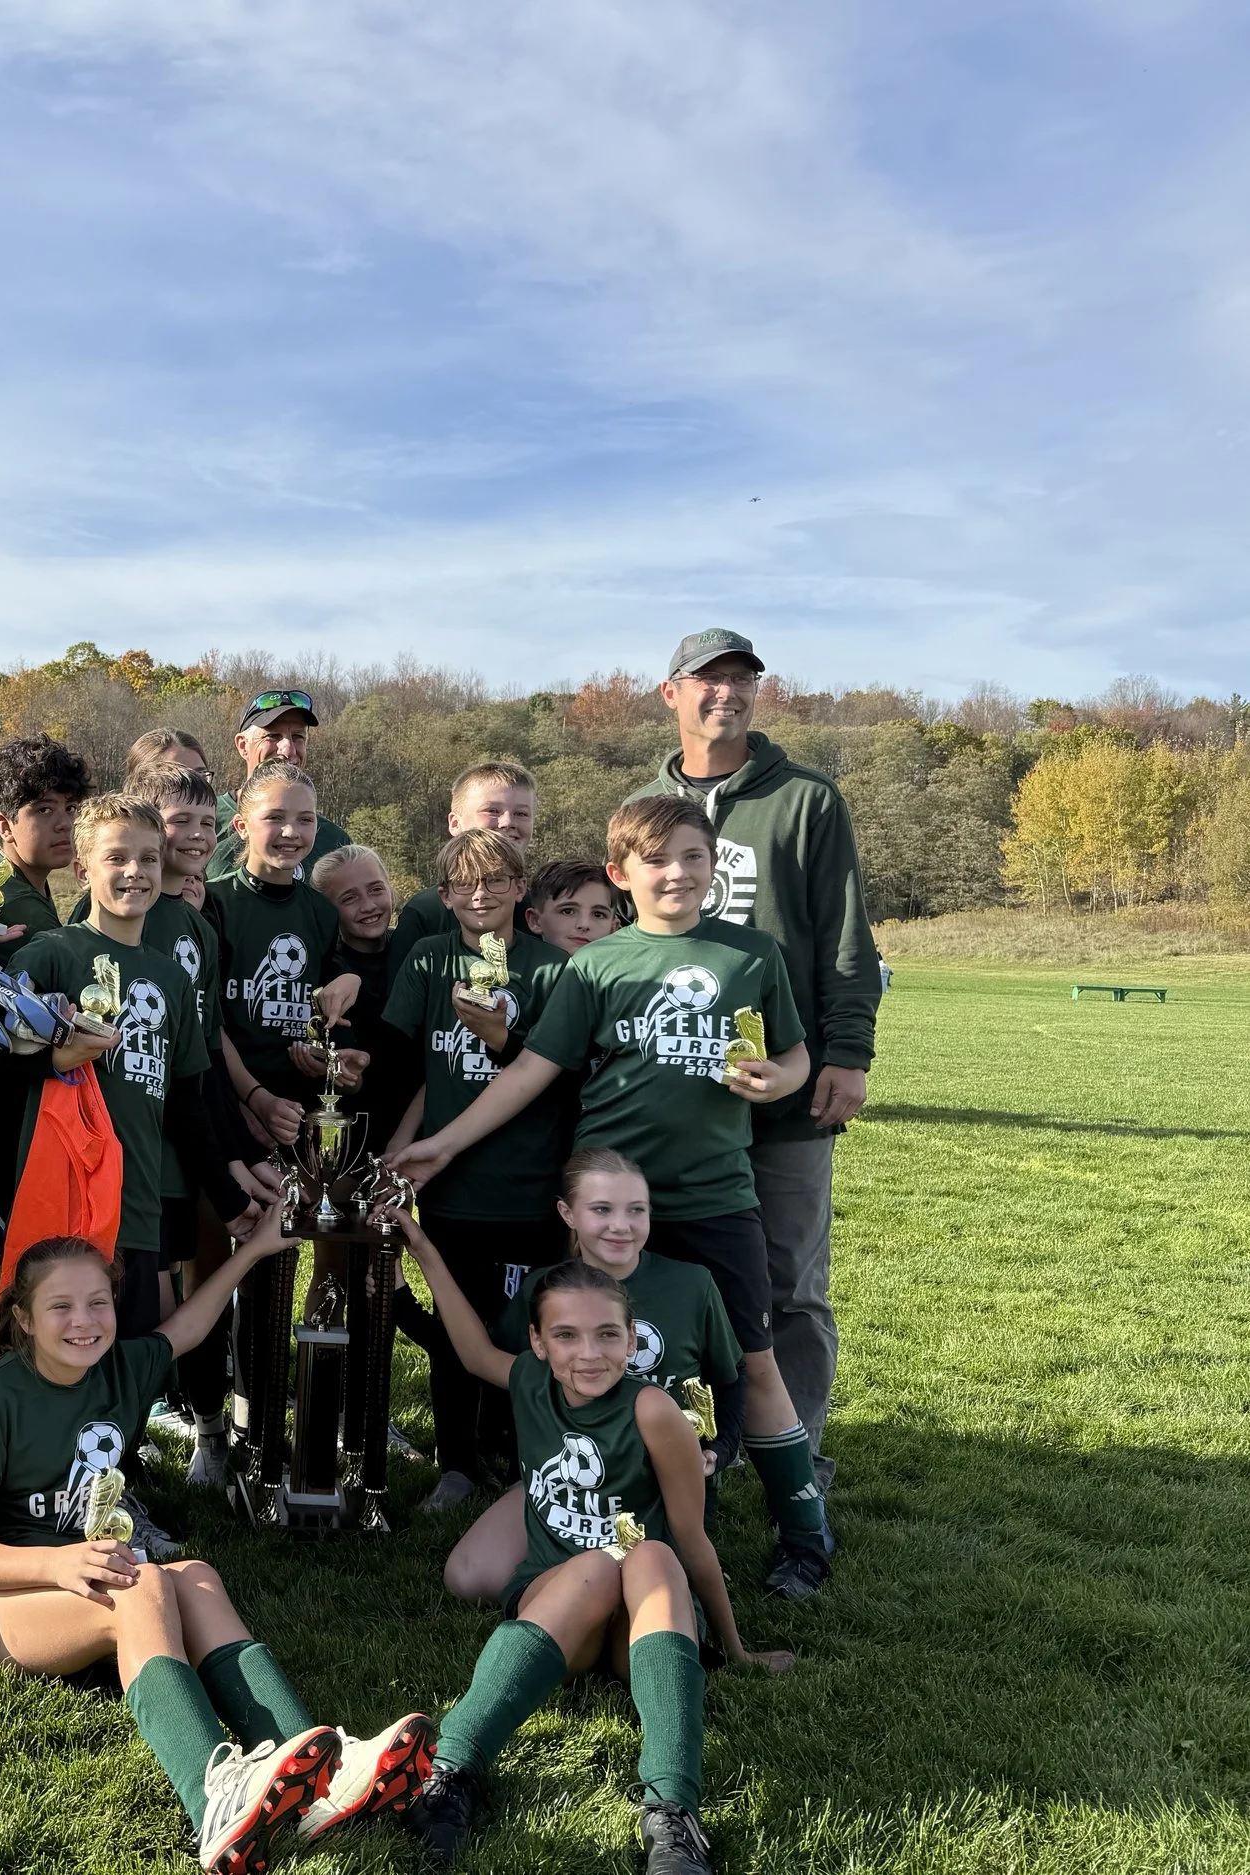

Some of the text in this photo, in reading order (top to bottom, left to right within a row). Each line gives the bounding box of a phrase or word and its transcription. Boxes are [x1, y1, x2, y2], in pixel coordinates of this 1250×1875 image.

[226, 978, 312, 1003] GREENE
[270, 1004, 304, 1018] JRC
[261, 1020, 308, 1029] SOCCER
[281, 1028, 307, 1037] 2025
[615, 1014, 731, 1042] GREENE
[122, 1025, 169, 1062] EENE
[431, 1030, 486, 1053] GRE
[667, 1039, 721, 1056] JRC
[656, 1057, 726, 1068] SOCCER
[463, 1073, 498, 1081] SOC
[684, 1066, 712, 1077] 20
[124, 1073, 163, 1089] SOCCE
[523, 1466, 622, 1517] REENE
[29, 1486, 90, 1518] GRE
[559, 1514, 613, 1535] JRC
